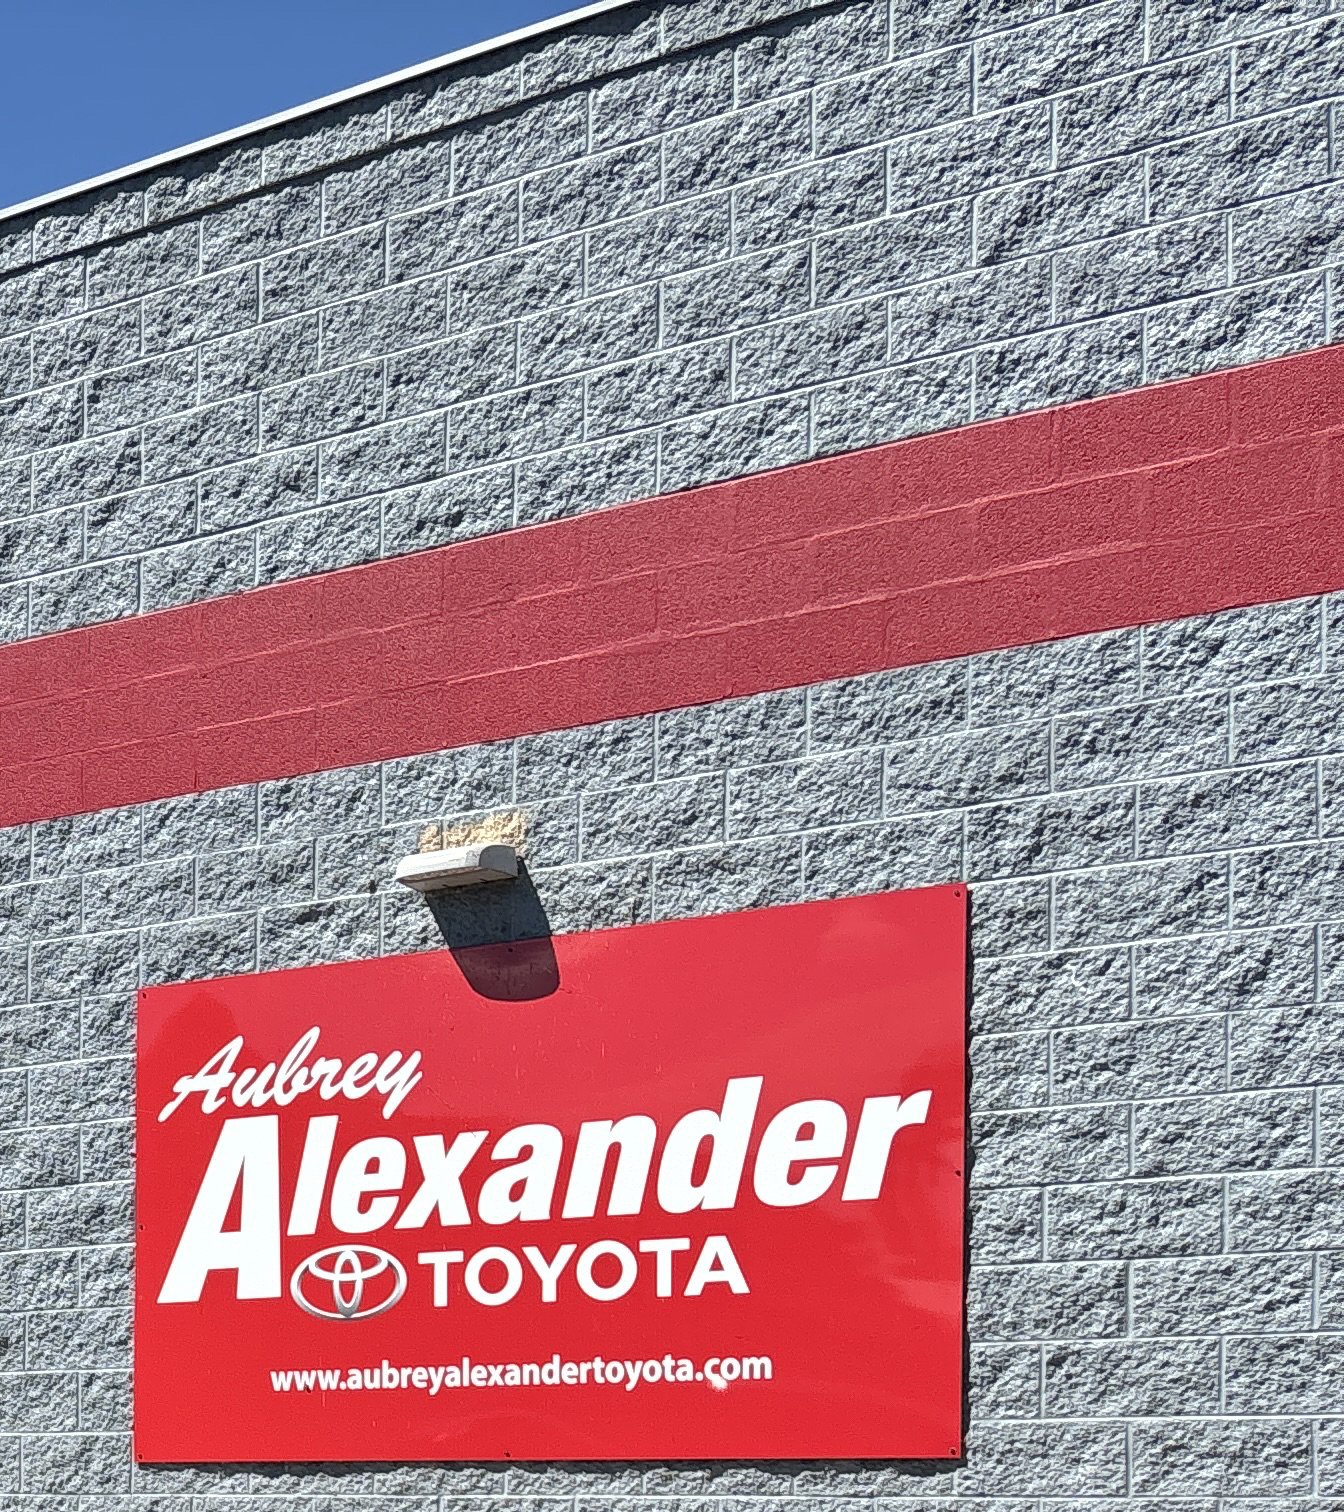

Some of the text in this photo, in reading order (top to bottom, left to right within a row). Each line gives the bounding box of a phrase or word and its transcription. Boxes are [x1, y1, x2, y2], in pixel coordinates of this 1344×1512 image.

[157, 1025, 423, 1122] Aubrey
[156, 1075, 933, 1304] Alexander
[417, 1235, 751, 1308] TOYOTA
[270, 1353, 773, 1396] www.aubreyalexandertoyota.com
